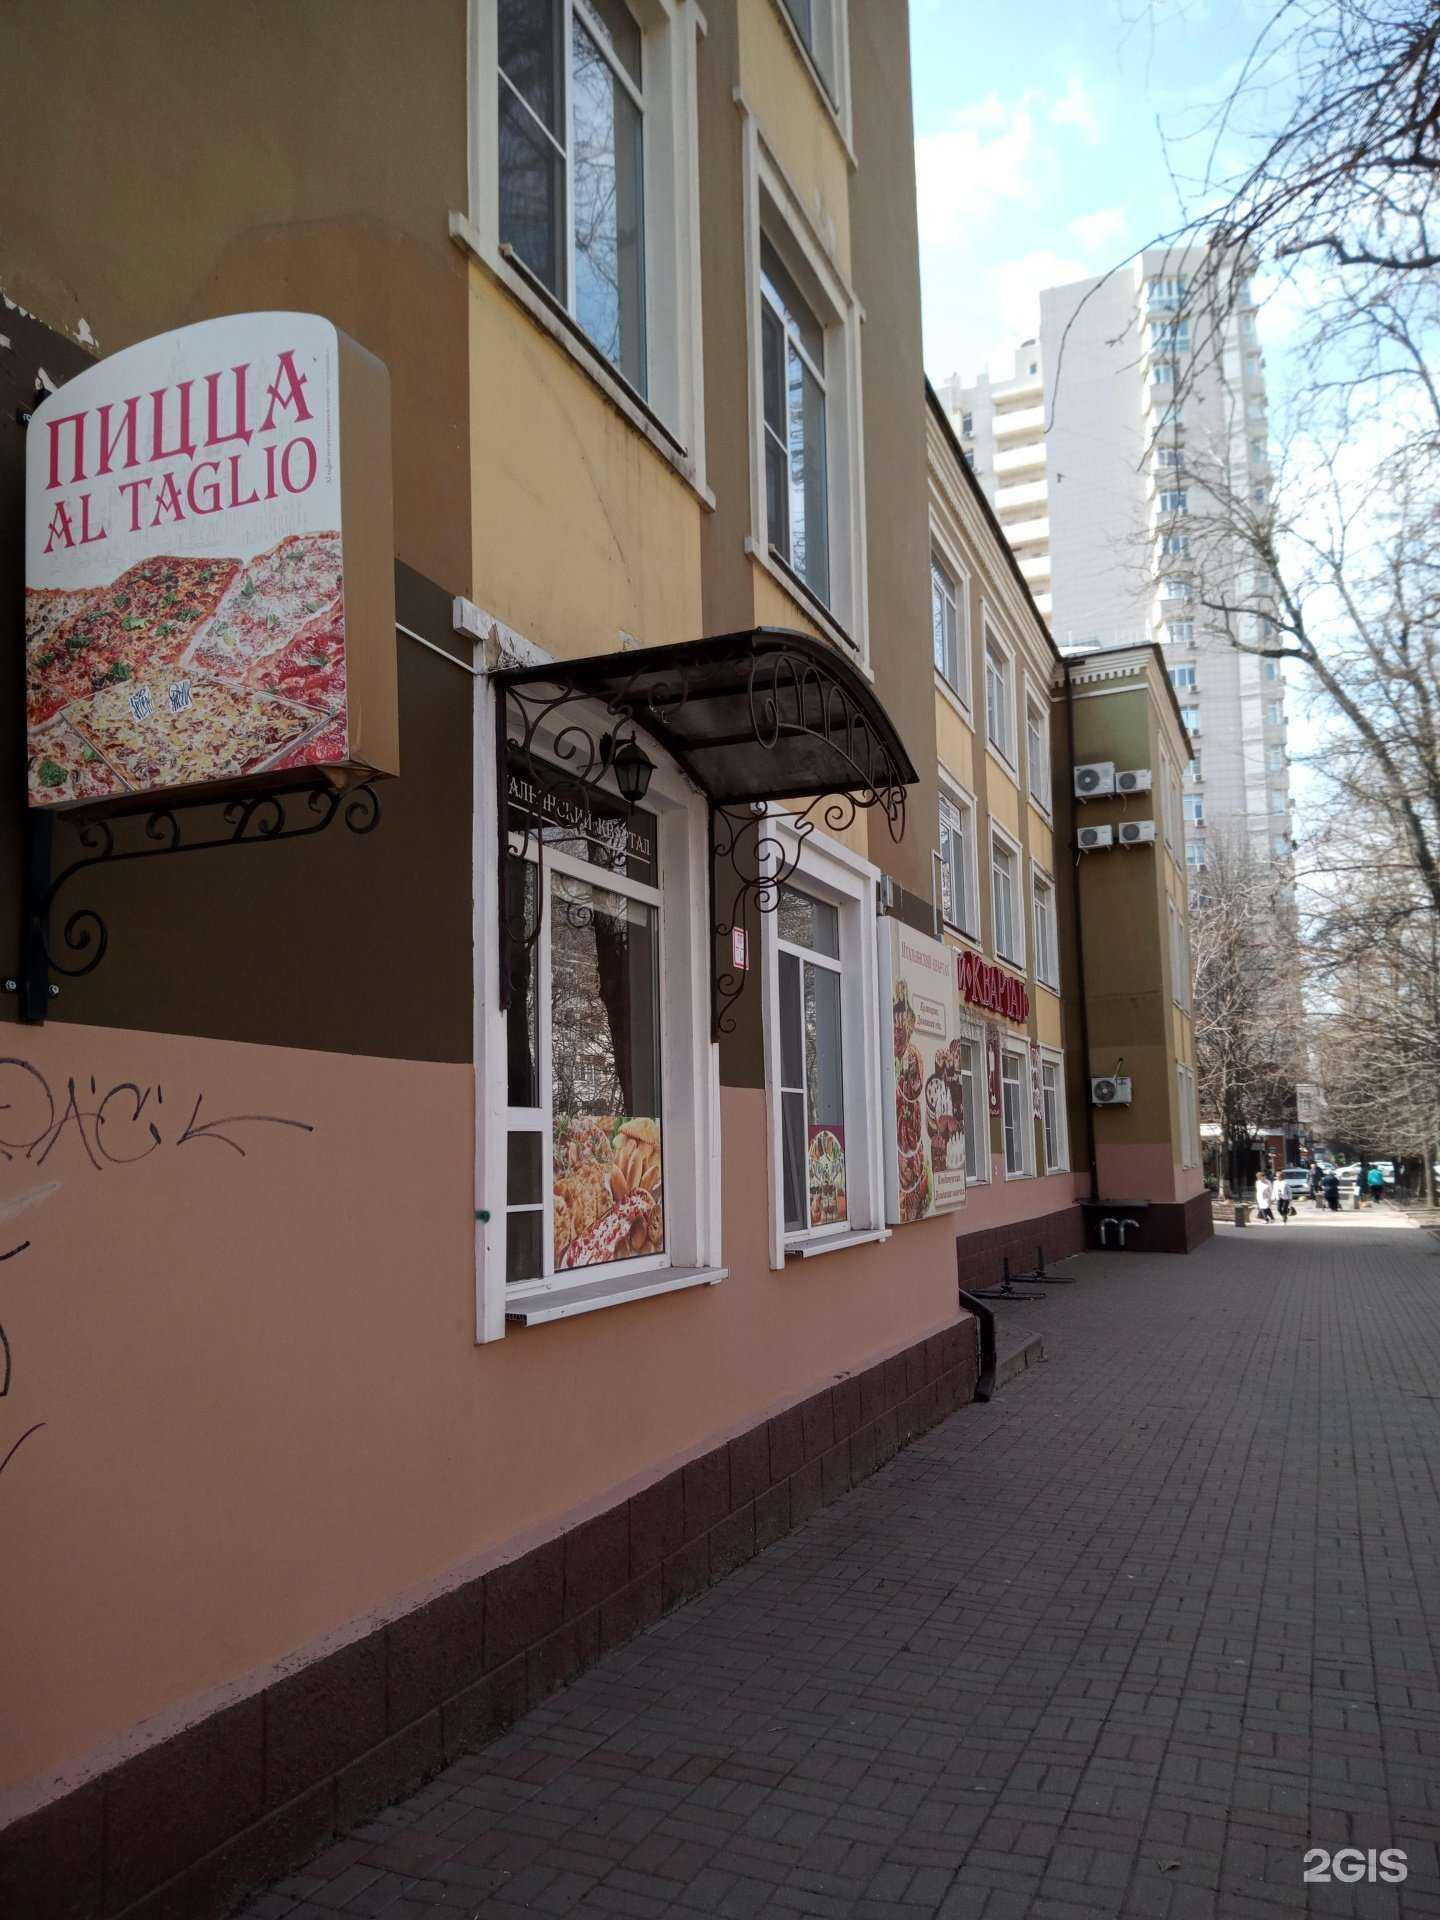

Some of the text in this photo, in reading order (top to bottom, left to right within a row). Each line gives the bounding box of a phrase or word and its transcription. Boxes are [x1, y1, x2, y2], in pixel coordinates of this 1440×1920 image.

[45, 348, 315, 491] ПИЦЦА
[43, 437, 318, 555] AL TAGLIO
[972, 954, 1025, 1023] КВАРТАЛ
